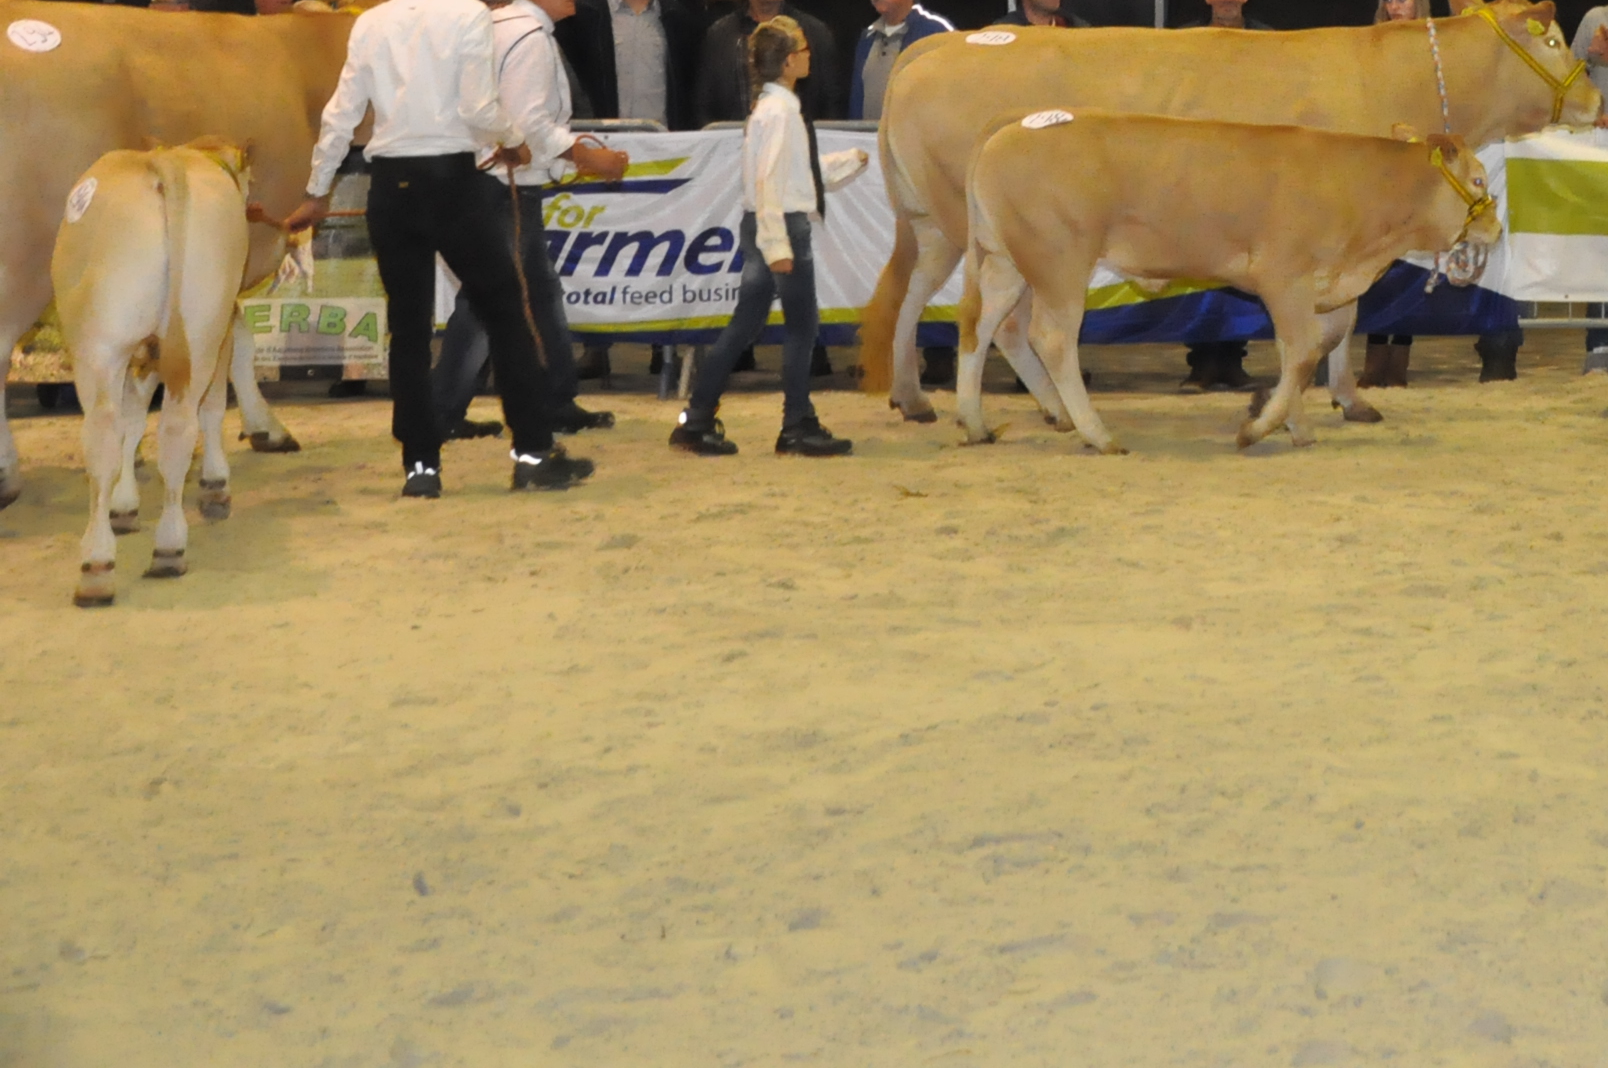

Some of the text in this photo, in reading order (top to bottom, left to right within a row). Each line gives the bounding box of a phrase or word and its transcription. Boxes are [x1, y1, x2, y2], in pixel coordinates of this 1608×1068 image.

[543, 192, 607, 229] for
[622, 285, 673, 304] feed
[244, 303, 379, 343] ERBA
